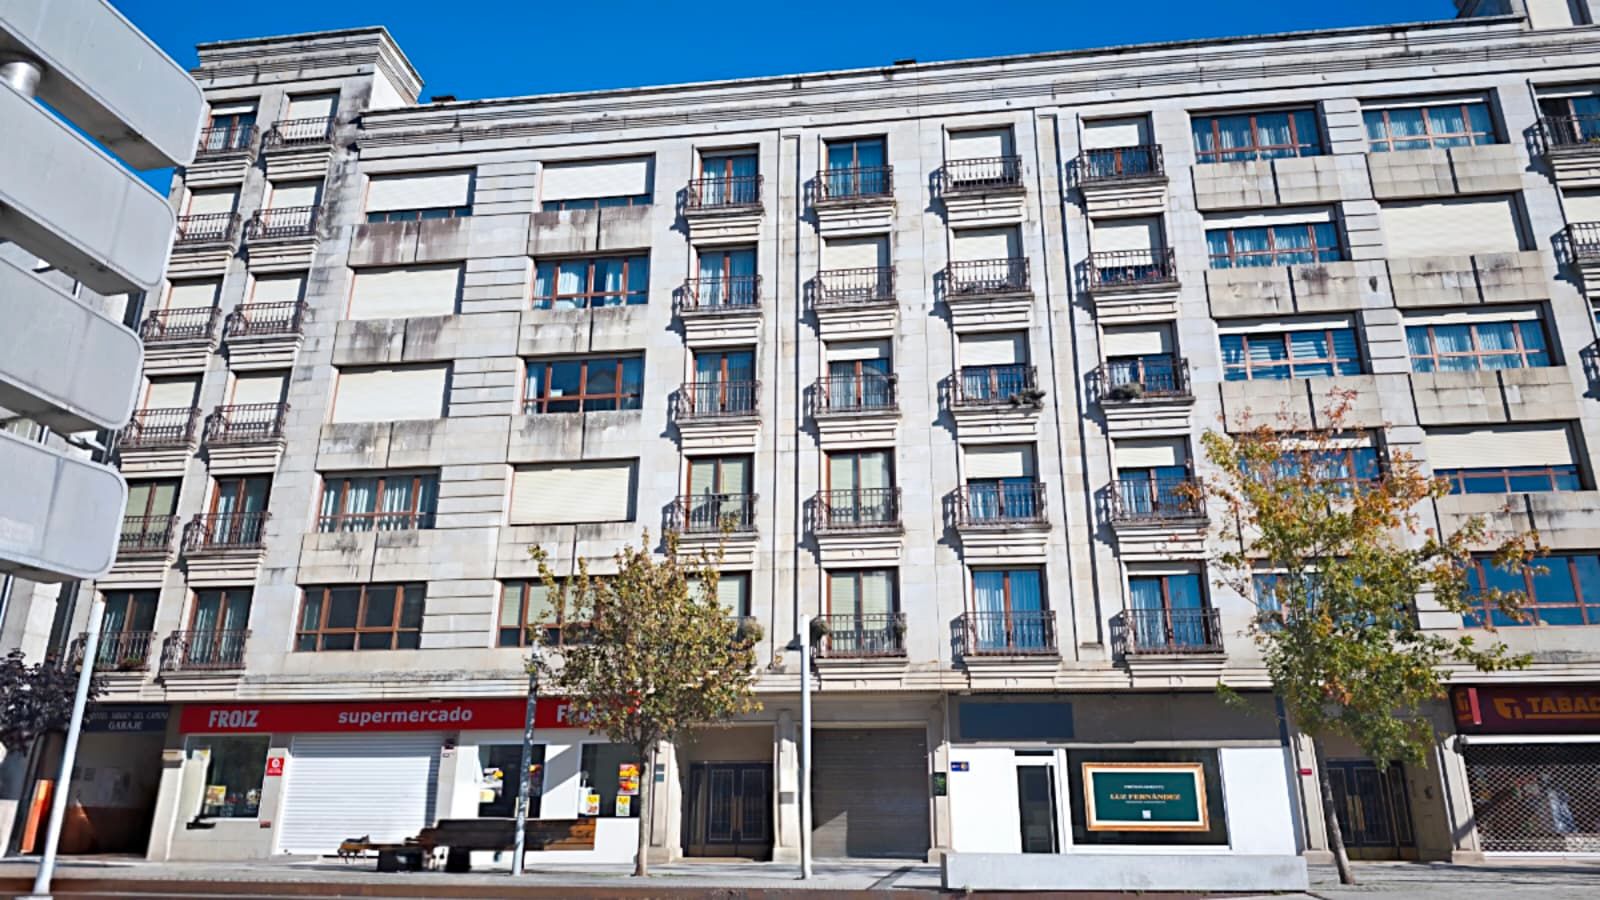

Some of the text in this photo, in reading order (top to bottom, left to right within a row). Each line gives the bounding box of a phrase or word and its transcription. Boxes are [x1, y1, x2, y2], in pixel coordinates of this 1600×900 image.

[108, 720, 144, 730] GARAJE
[208, 710, 259, 728] FROIZ
[338, 706, 473, 727] supermercado
